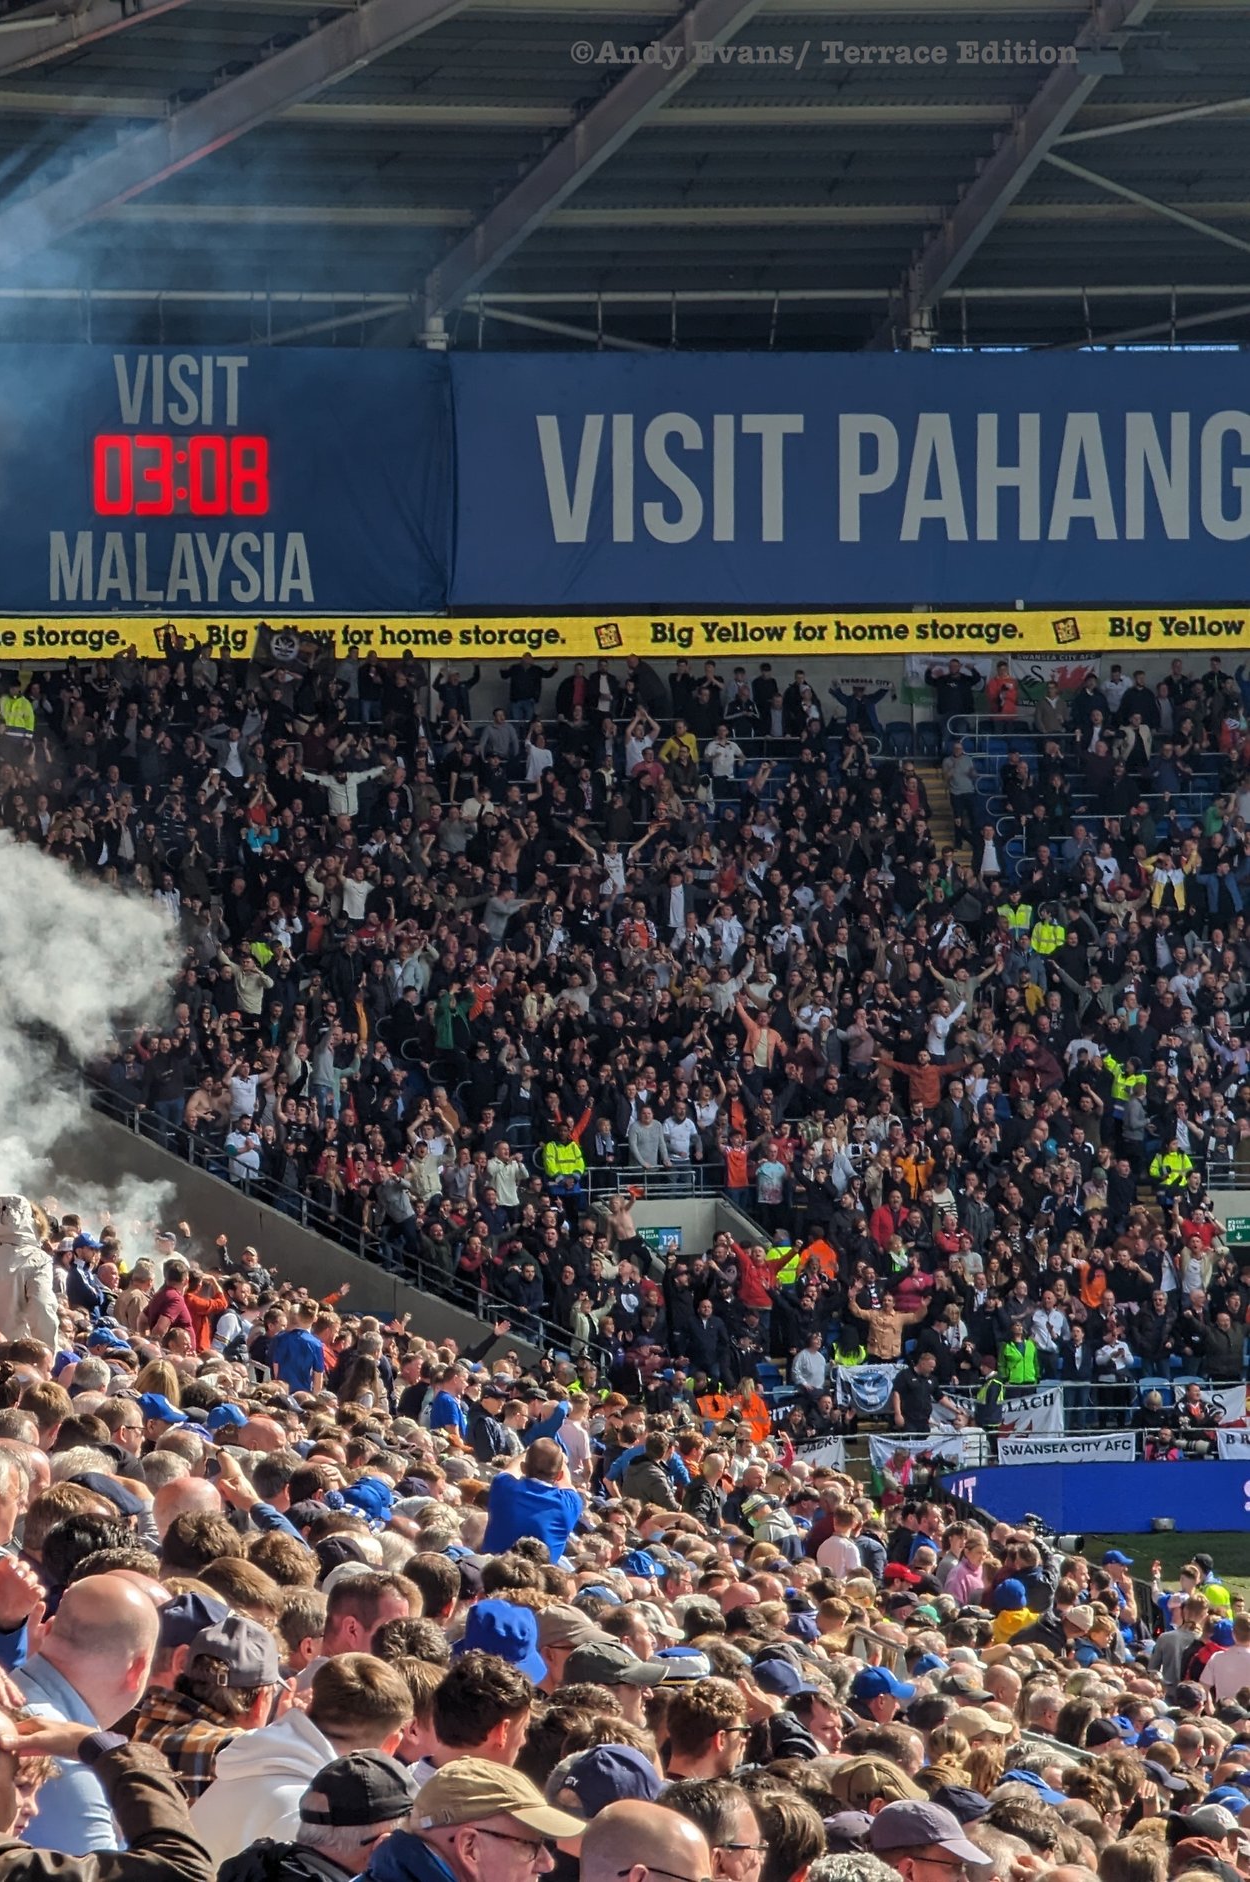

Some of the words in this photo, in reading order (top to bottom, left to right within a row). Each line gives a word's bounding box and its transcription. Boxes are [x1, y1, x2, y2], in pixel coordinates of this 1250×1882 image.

[113, 354, 248, 426] VISIT
[93, 434, 270, 516] 03:08
[536, 412, 804, 544] VISIT
[838, 410, 1250, 542] PAHANG
[50, 531, 314, 602] MALAYSIA
[23, 624, 126, 651] storage.
[206, 625, 247, 650] Big
[342, 624, 375, 645] for
[380, 624, 453, 646] home
[460, 624, 566, 650] storage.
[650, 622, 694, 648] Big
[701, 622, 786, 643] Yellow
[793, 620, 829, 642] for
[834, 620, 910, 642] home
[916, 618, 1024, 644] storage.
[1108, 616, 1152, 642] Big
[1158, 615, 1245, 637] Yellow
[662, 1234, 679, 1246] 121
[1002, 1393, 1054, 1414] LACH
[1001, 1443, 1068, 1456] SWANSEA
[1071, 1441, 1101, 1453] CITY
[1106, 1439, 1132, 1451] AFC
